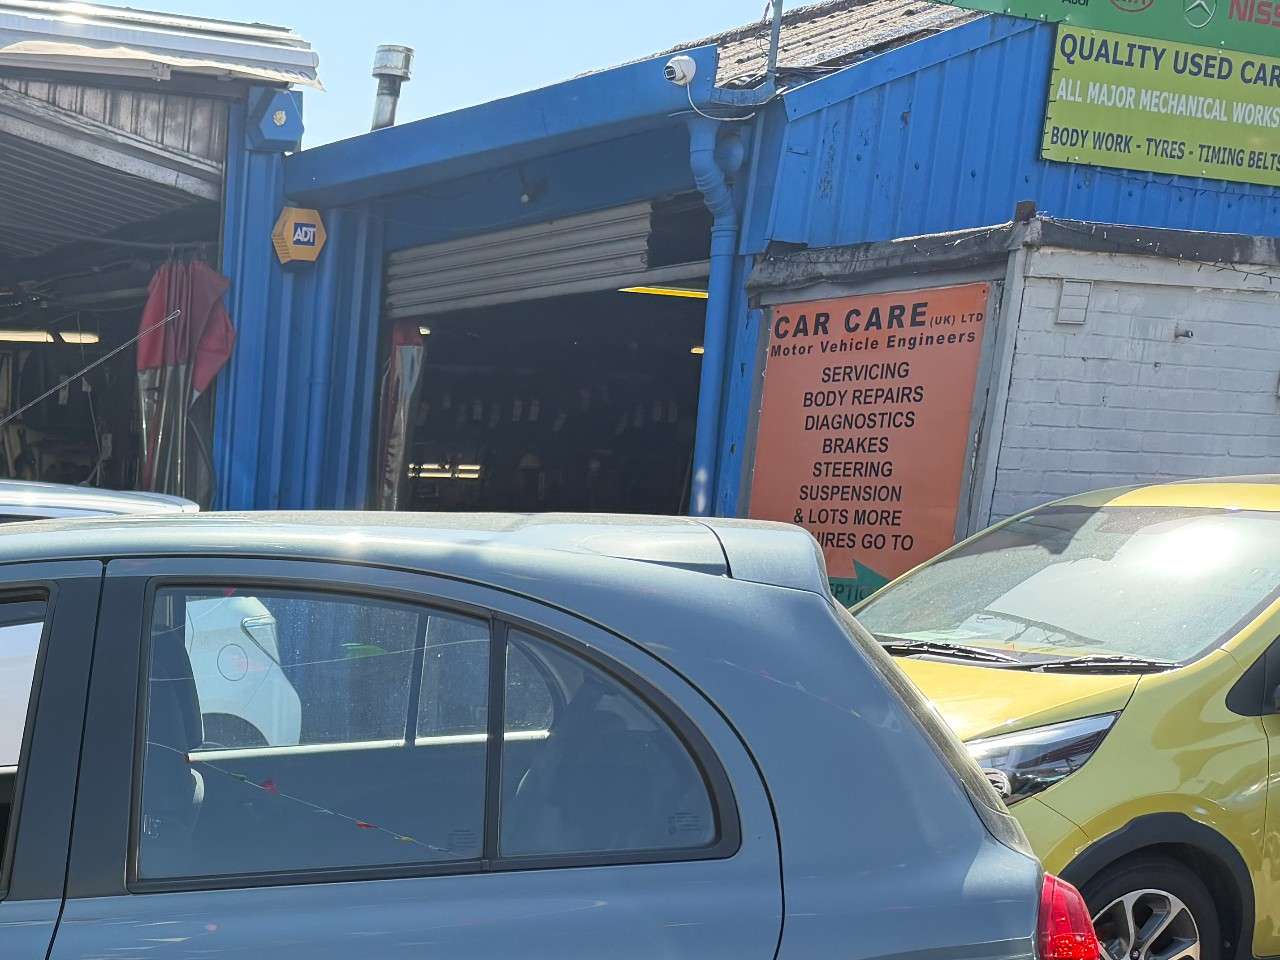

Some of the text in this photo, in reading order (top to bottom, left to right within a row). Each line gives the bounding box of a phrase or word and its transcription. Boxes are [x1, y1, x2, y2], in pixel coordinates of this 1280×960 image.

[1060, 33, 1167, 71] QUALITY
[1173, 50, 1233, 81] USED
[1056, 77, 1280, 128] ALL MAJOR MECHANICAL WORKS
[1051, 126, 1089, 147] BODY
[1092, 131, 1133, 154] WORK
[1146, 137, 1186, 160] TYRES
[1198, 144, 1244, 167] TIMING
[293, 226, 316, 243] ADT
[774, 302, 984, 339] CAR CARE (UK) LTD
[771, 331, 976, 357] Motor Vehicle Engineers
[821, 361, 910, 383] SERVICING
[803, 386, 924, 407] BODY REPAIRS
[804, 411, 916, 431] DIAGNOSTICS
[822, 436, 889, 454] BRAKES
[812, 461, 893, 478] STEERING
[799, 485, 902, 502] SUSPENSION
[793, 508, 902, 526] & LOTS MORE
[861, 533, 886, 550] GO
[891, 534, 914, 551] TO
